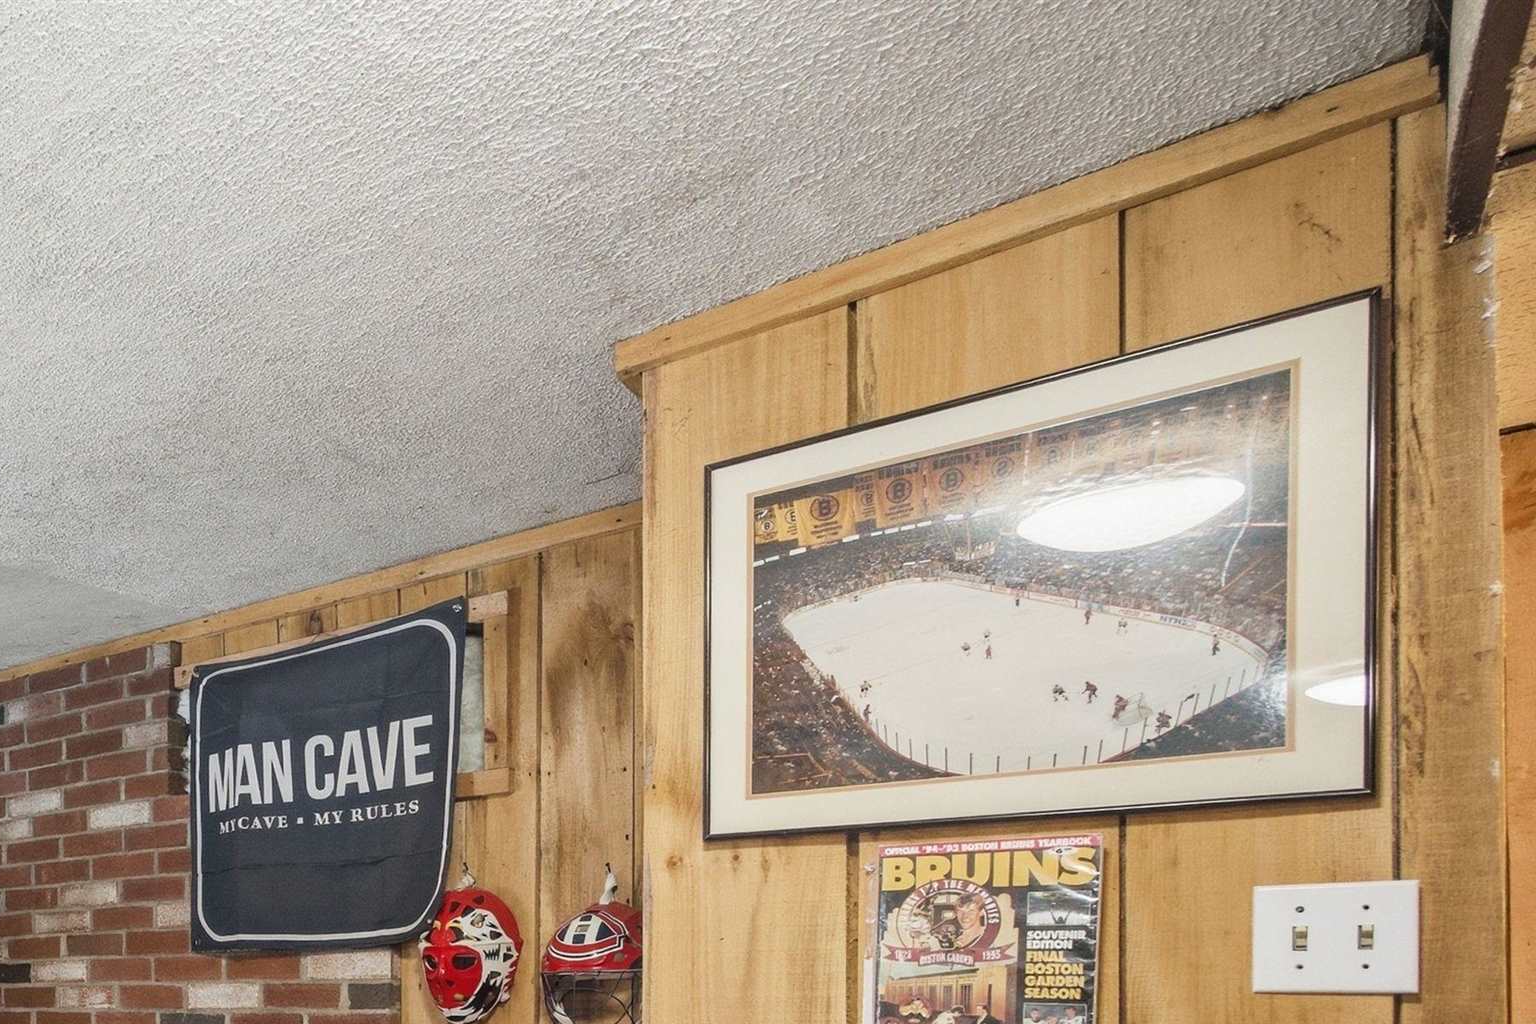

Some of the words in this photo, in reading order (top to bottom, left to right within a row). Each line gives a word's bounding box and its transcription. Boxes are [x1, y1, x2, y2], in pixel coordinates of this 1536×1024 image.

[209, 739, 294, 813] MAN
[304, 714, 434, 800] CAVE
[237, 815, 289, 830] CAVE
[314, 810, 343, 826] MY
[350, 800, 420, 823] RULES
[881, 847, 1097, 892] BRUINS
[944, 880, 963, 889] THE
[1026, 929, 1087, 940] SOUVENIR
[1026, 940, 1073, 950] EDITION
[1026, 950, 1066, 963] FINAL
[1025, 963, 1084, 975] BOSTON
[1024, 975, 1085, 988] GARDEN
[1024, 987, 1082, 1000] SEASON
